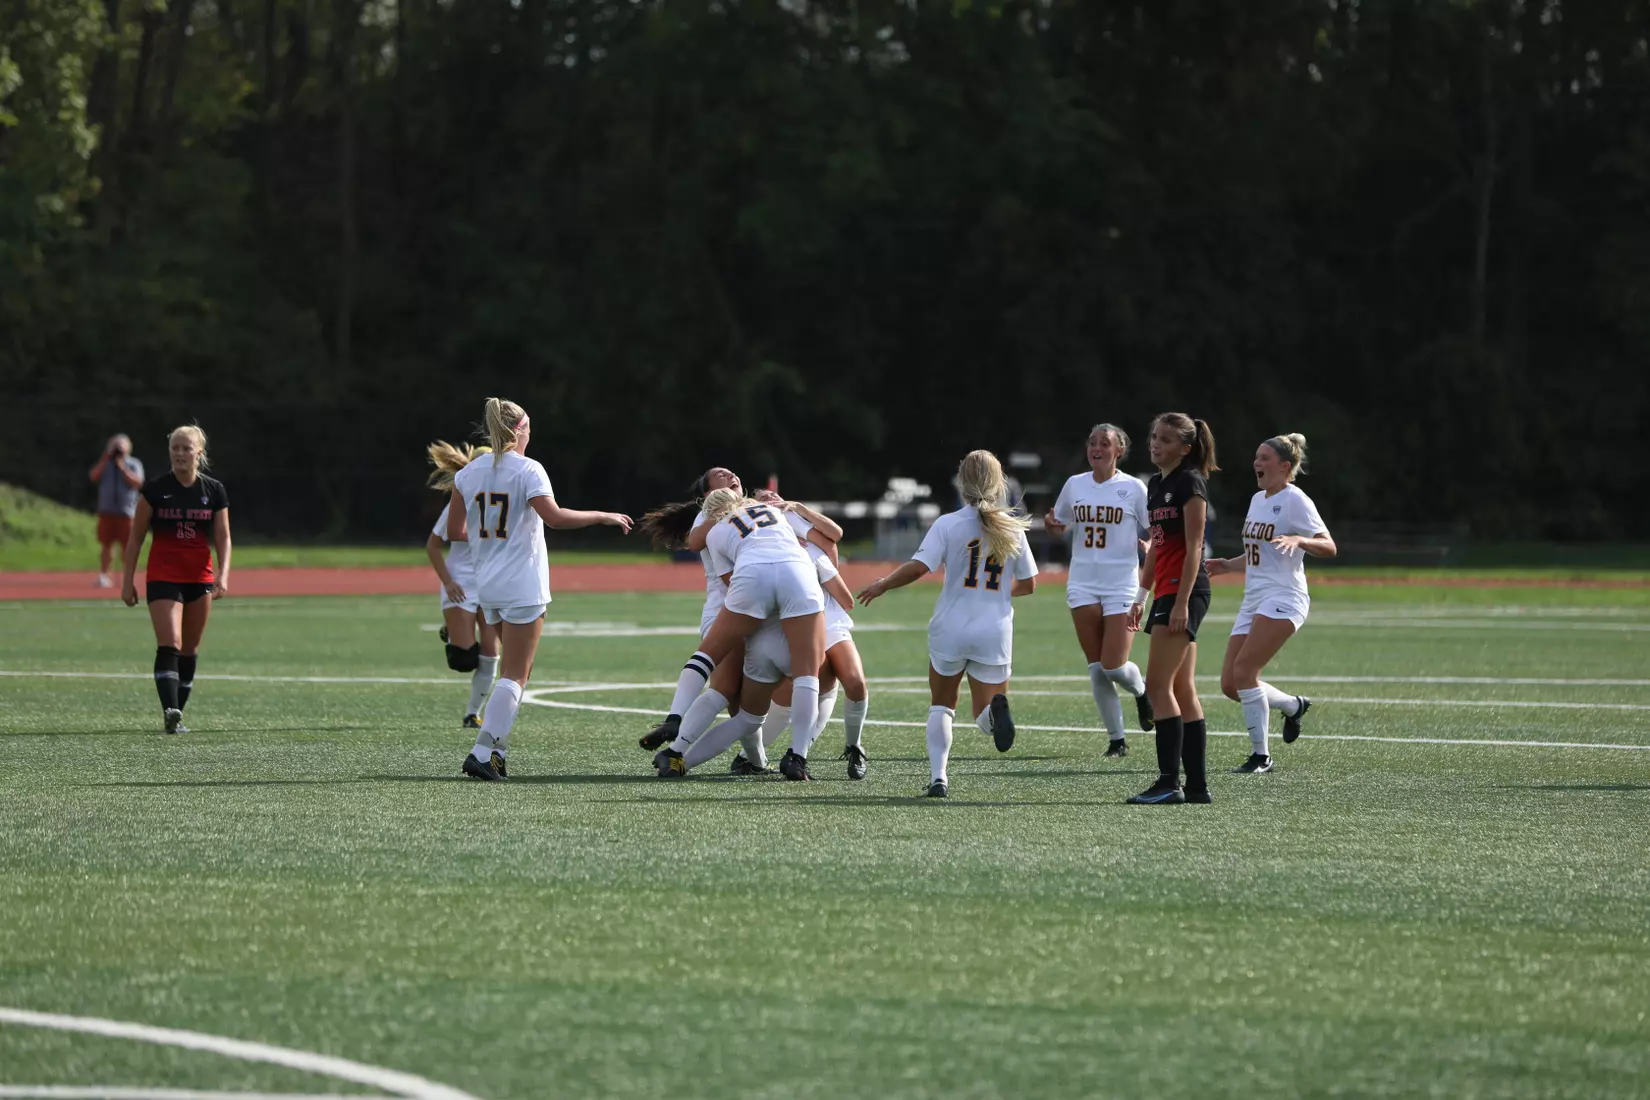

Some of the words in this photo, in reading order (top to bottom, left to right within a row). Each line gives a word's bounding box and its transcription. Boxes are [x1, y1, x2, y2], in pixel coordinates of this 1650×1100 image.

[475, 491, 509, 539] 17
[728, 504, 778, 539] 15
[1073, 505, 1124, 525] TOLEDO
[176, 521, 197, 539] 15
[1084, 526, 1107, 549] 33
[1241, 520, 1275, 542] LEDO
[963, 538, 1005, 591] 14
